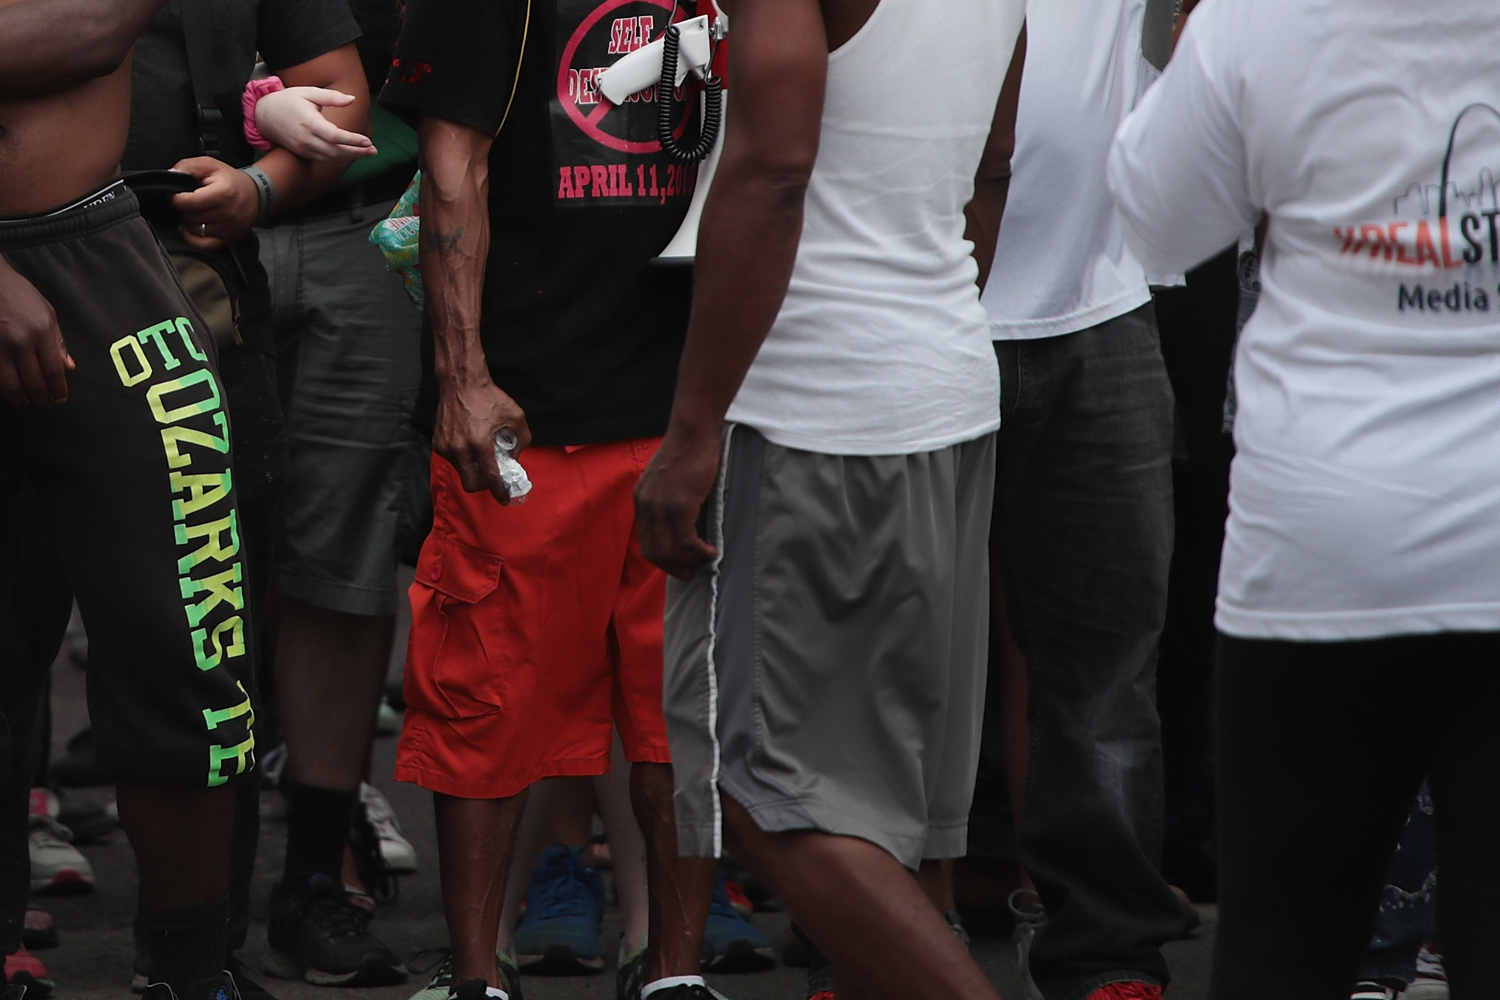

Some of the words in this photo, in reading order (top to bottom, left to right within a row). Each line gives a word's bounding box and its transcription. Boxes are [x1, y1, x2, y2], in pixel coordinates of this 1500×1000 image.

[608, 15, 654, 55] SELF
[558, 164, 633, 199] APRIL
[1398, 281, 1490, 313] Media
[145, 367, 247, 671] OZARKS
